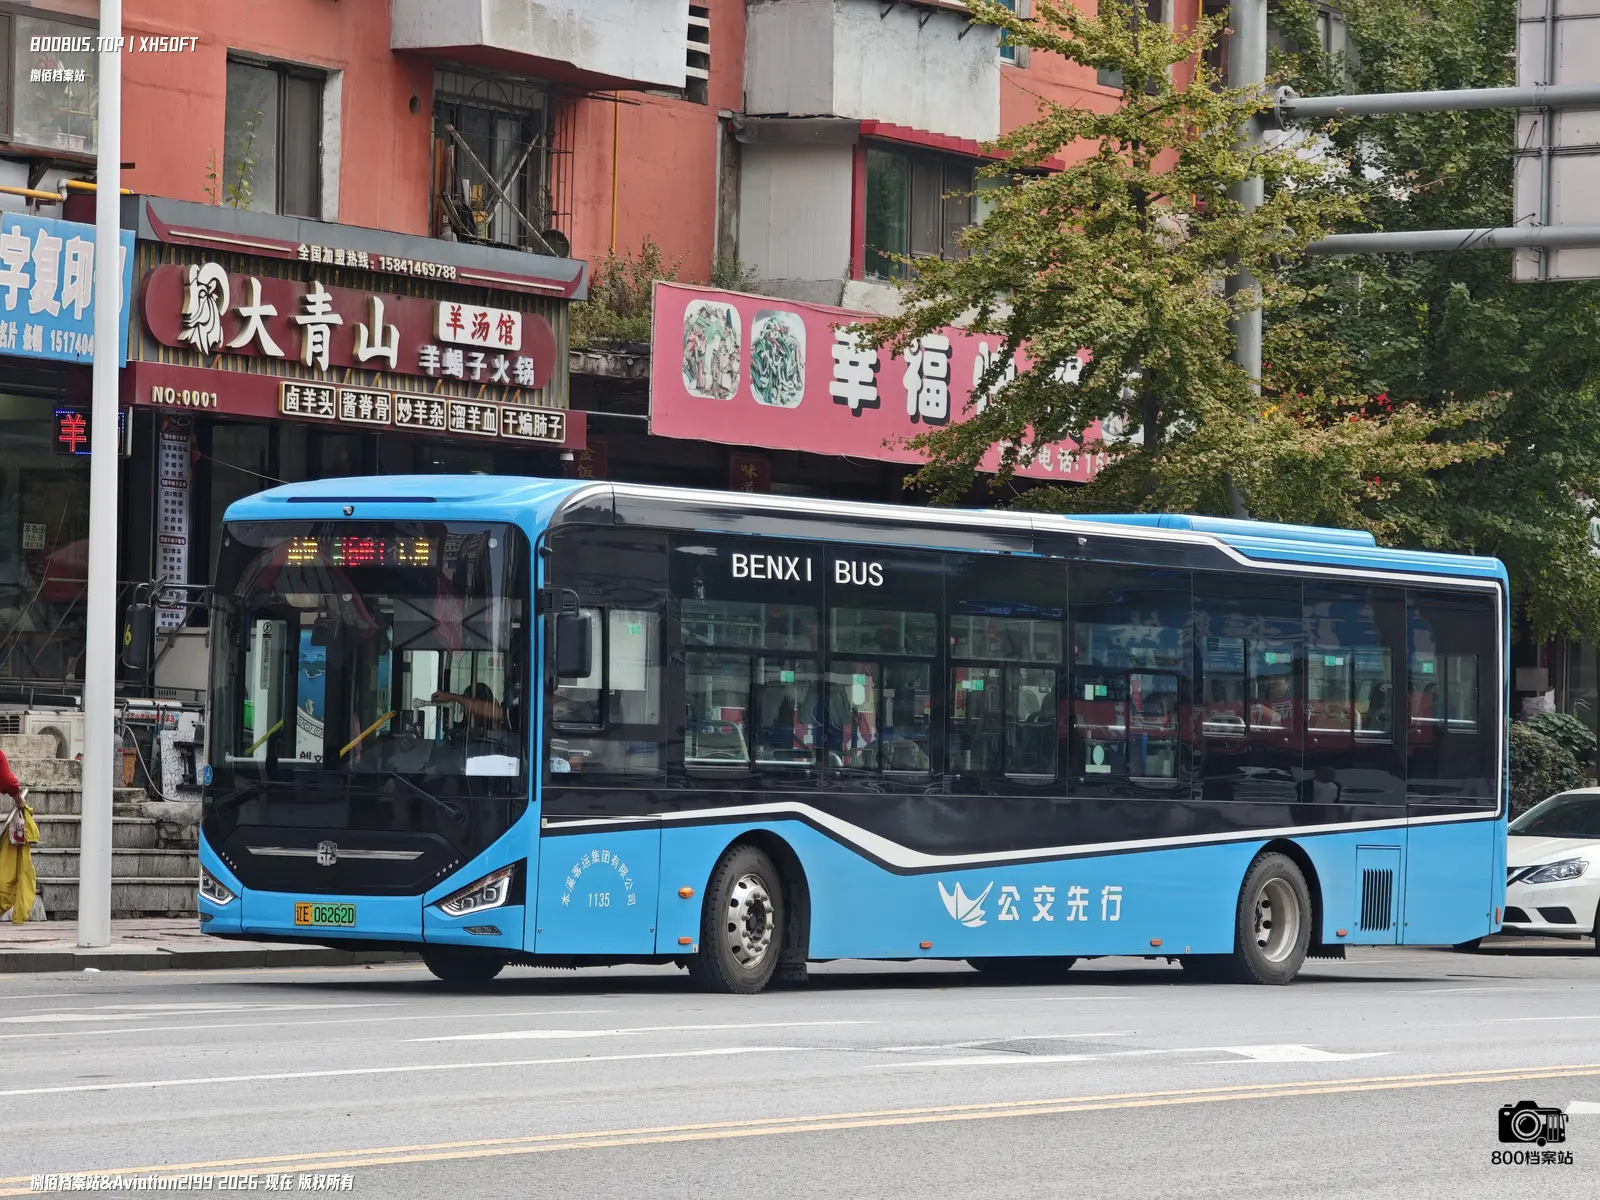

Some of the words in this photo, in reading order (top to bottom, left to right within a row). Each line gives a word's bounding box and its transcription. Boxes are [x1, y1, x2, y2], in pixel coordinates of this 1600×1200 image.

[0, 225, 127, 320] 字复印
[379, 256, 457, 280] 15841469788
[22, 322, 44, 353] 条幅
[226, 277, 400, 372] 大青山
[446, 305, 516, 346] 羊汤馆
[419, 345, 535, 386] 羊蝎子火锅
[151, 385, 217, 408] NO:0001
[286, 386, 334, 415] 卤羊头
[343, 392, 389, 421] 酱脊骨
[397, 398, 444, 427] 炒羊杂
[732, 553, 812, 582] BENXI
[835, 559, 884, 587] BUS
[588, 892, 611, 907] 1135
[997, 885, 1123, 922] 公交先行
